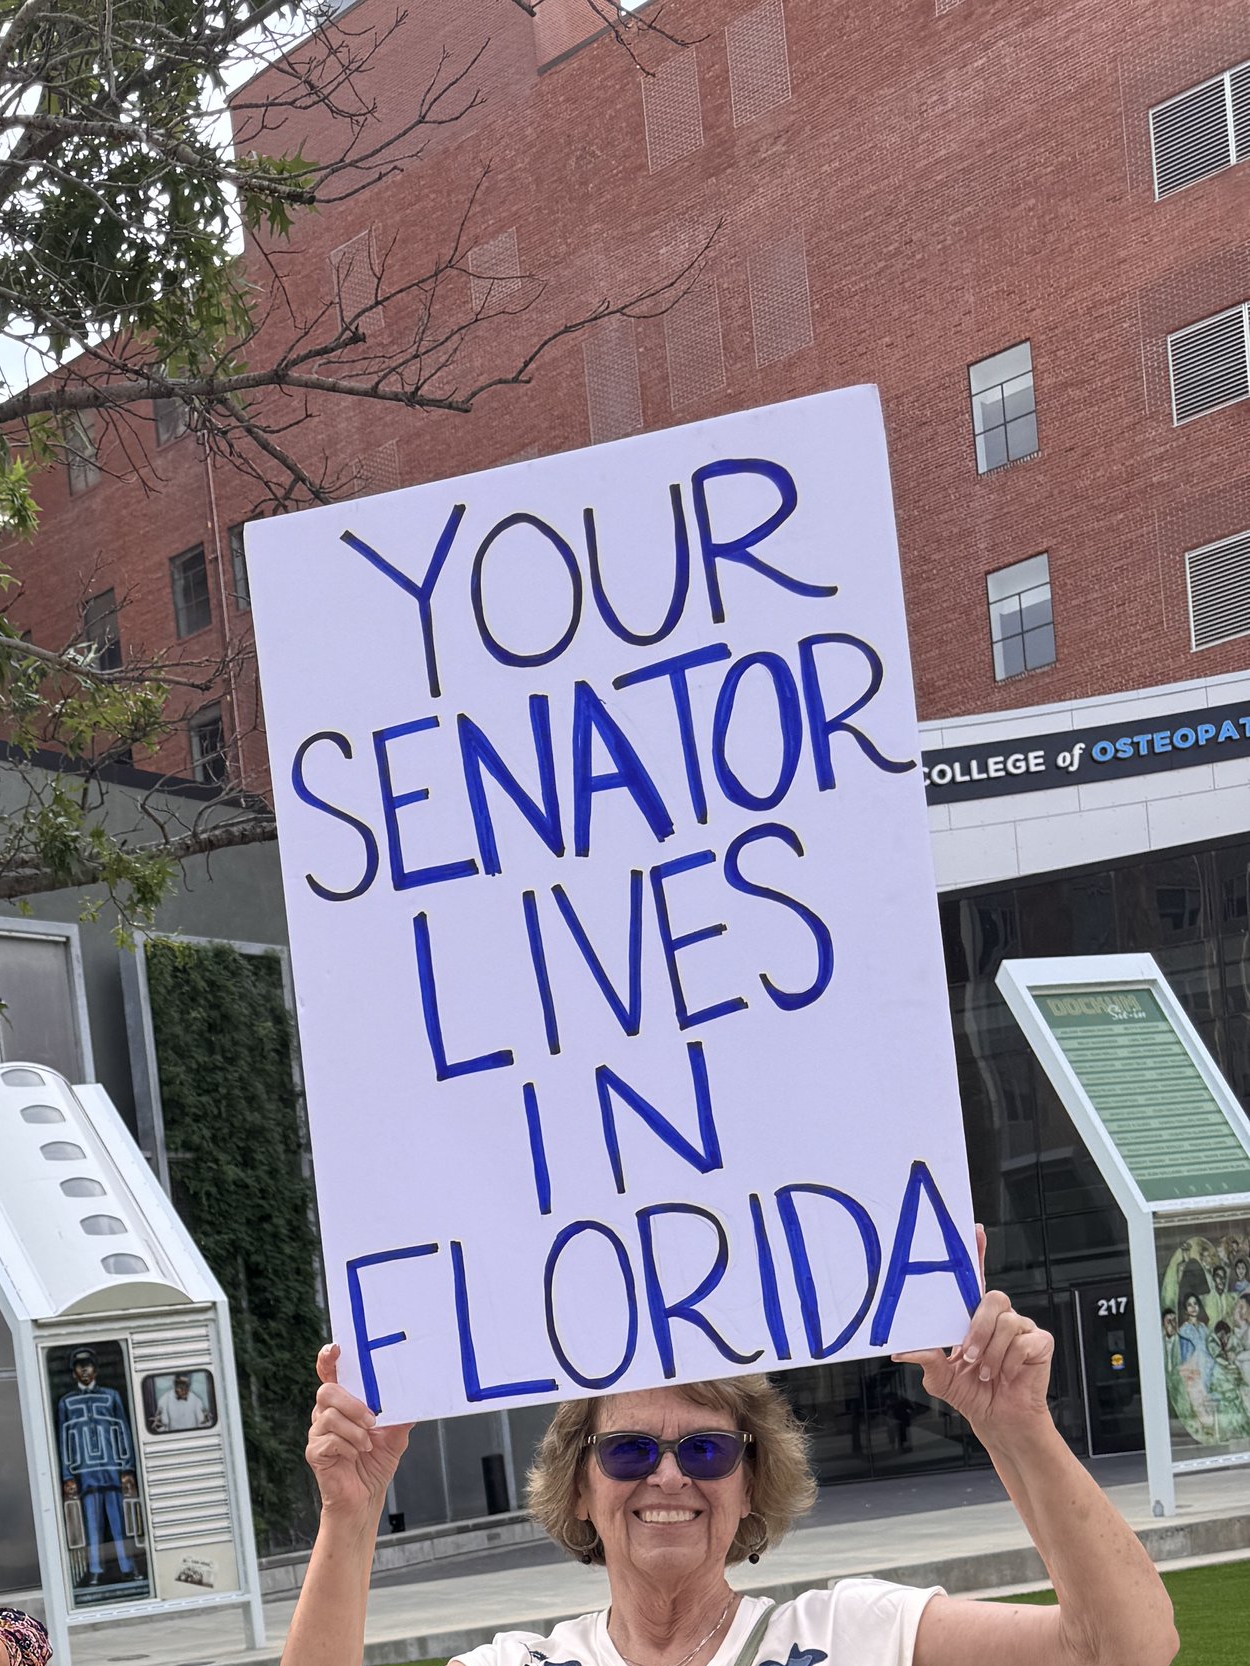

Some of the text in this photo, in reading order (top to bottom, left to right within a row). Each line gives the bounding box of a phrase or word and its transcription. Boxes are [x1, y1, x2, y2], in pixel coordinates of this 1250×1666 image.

[339, 457, 838, 698] YOUR
[290, 631, 916, 902] SENATOR
[1056, 742, 1086, 772] of
[413, 820, 835, 1081] LIVES
[523, 1040, 723, 1215] IN
[345, 1159, 983, 1415] FLORIDA
[1097, 1296, 1128, 1317] 217
